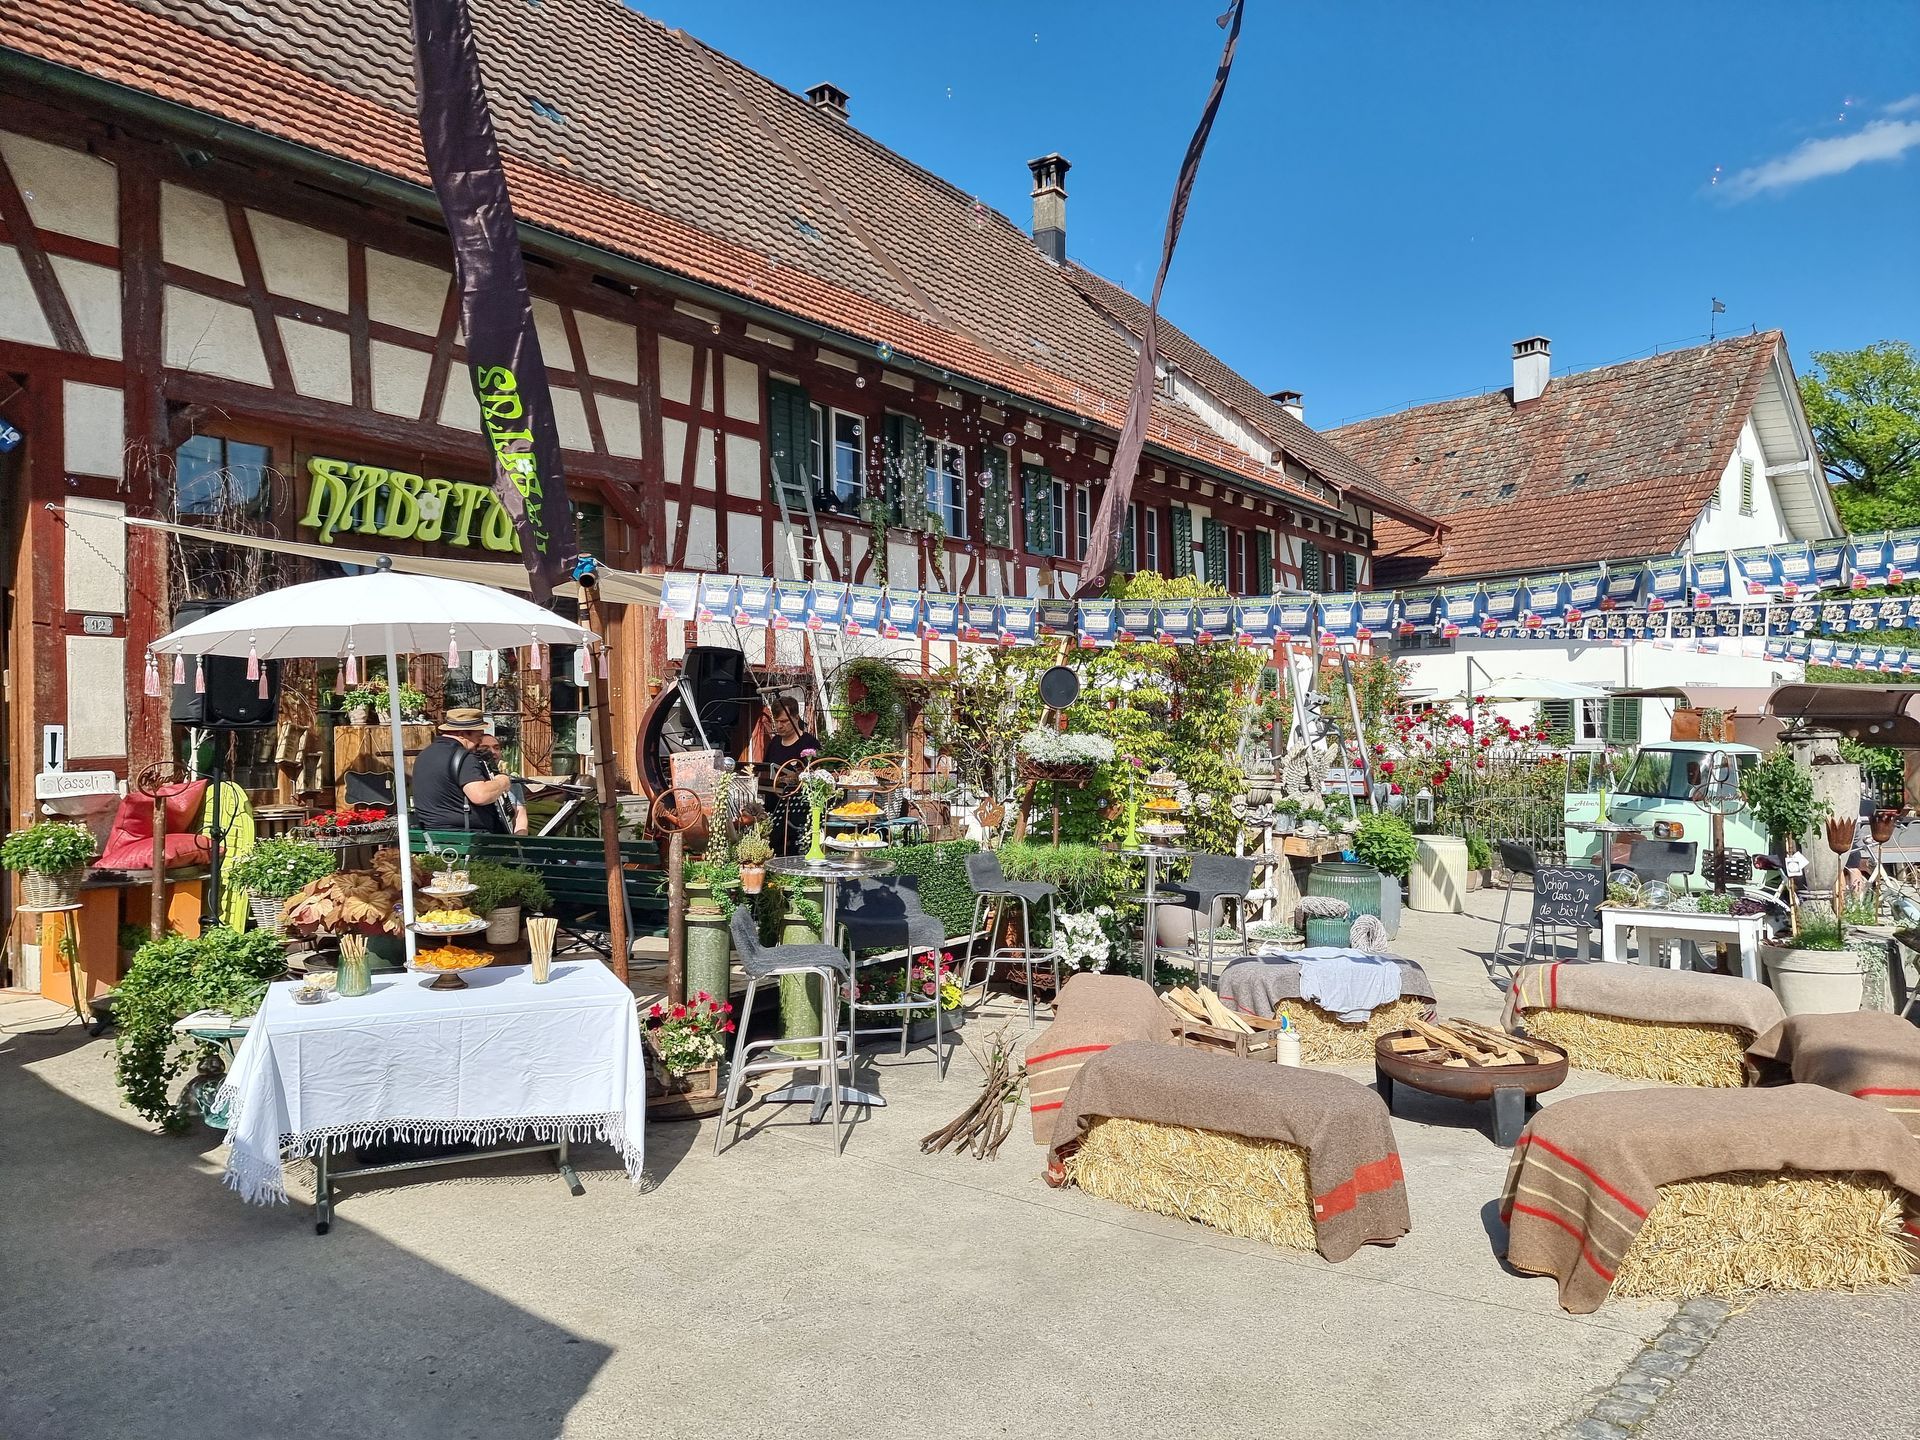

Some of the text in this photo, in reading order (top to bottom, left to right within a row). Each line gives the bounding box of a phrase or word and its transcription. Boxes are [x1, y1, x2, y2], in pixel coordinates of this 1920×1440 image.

[299, 457, 522, 554] HABITU
[91, 619, 106, 631] 92
[1573, 888, 1590, 903] Du
[1540, 902, 1552, 915] da
